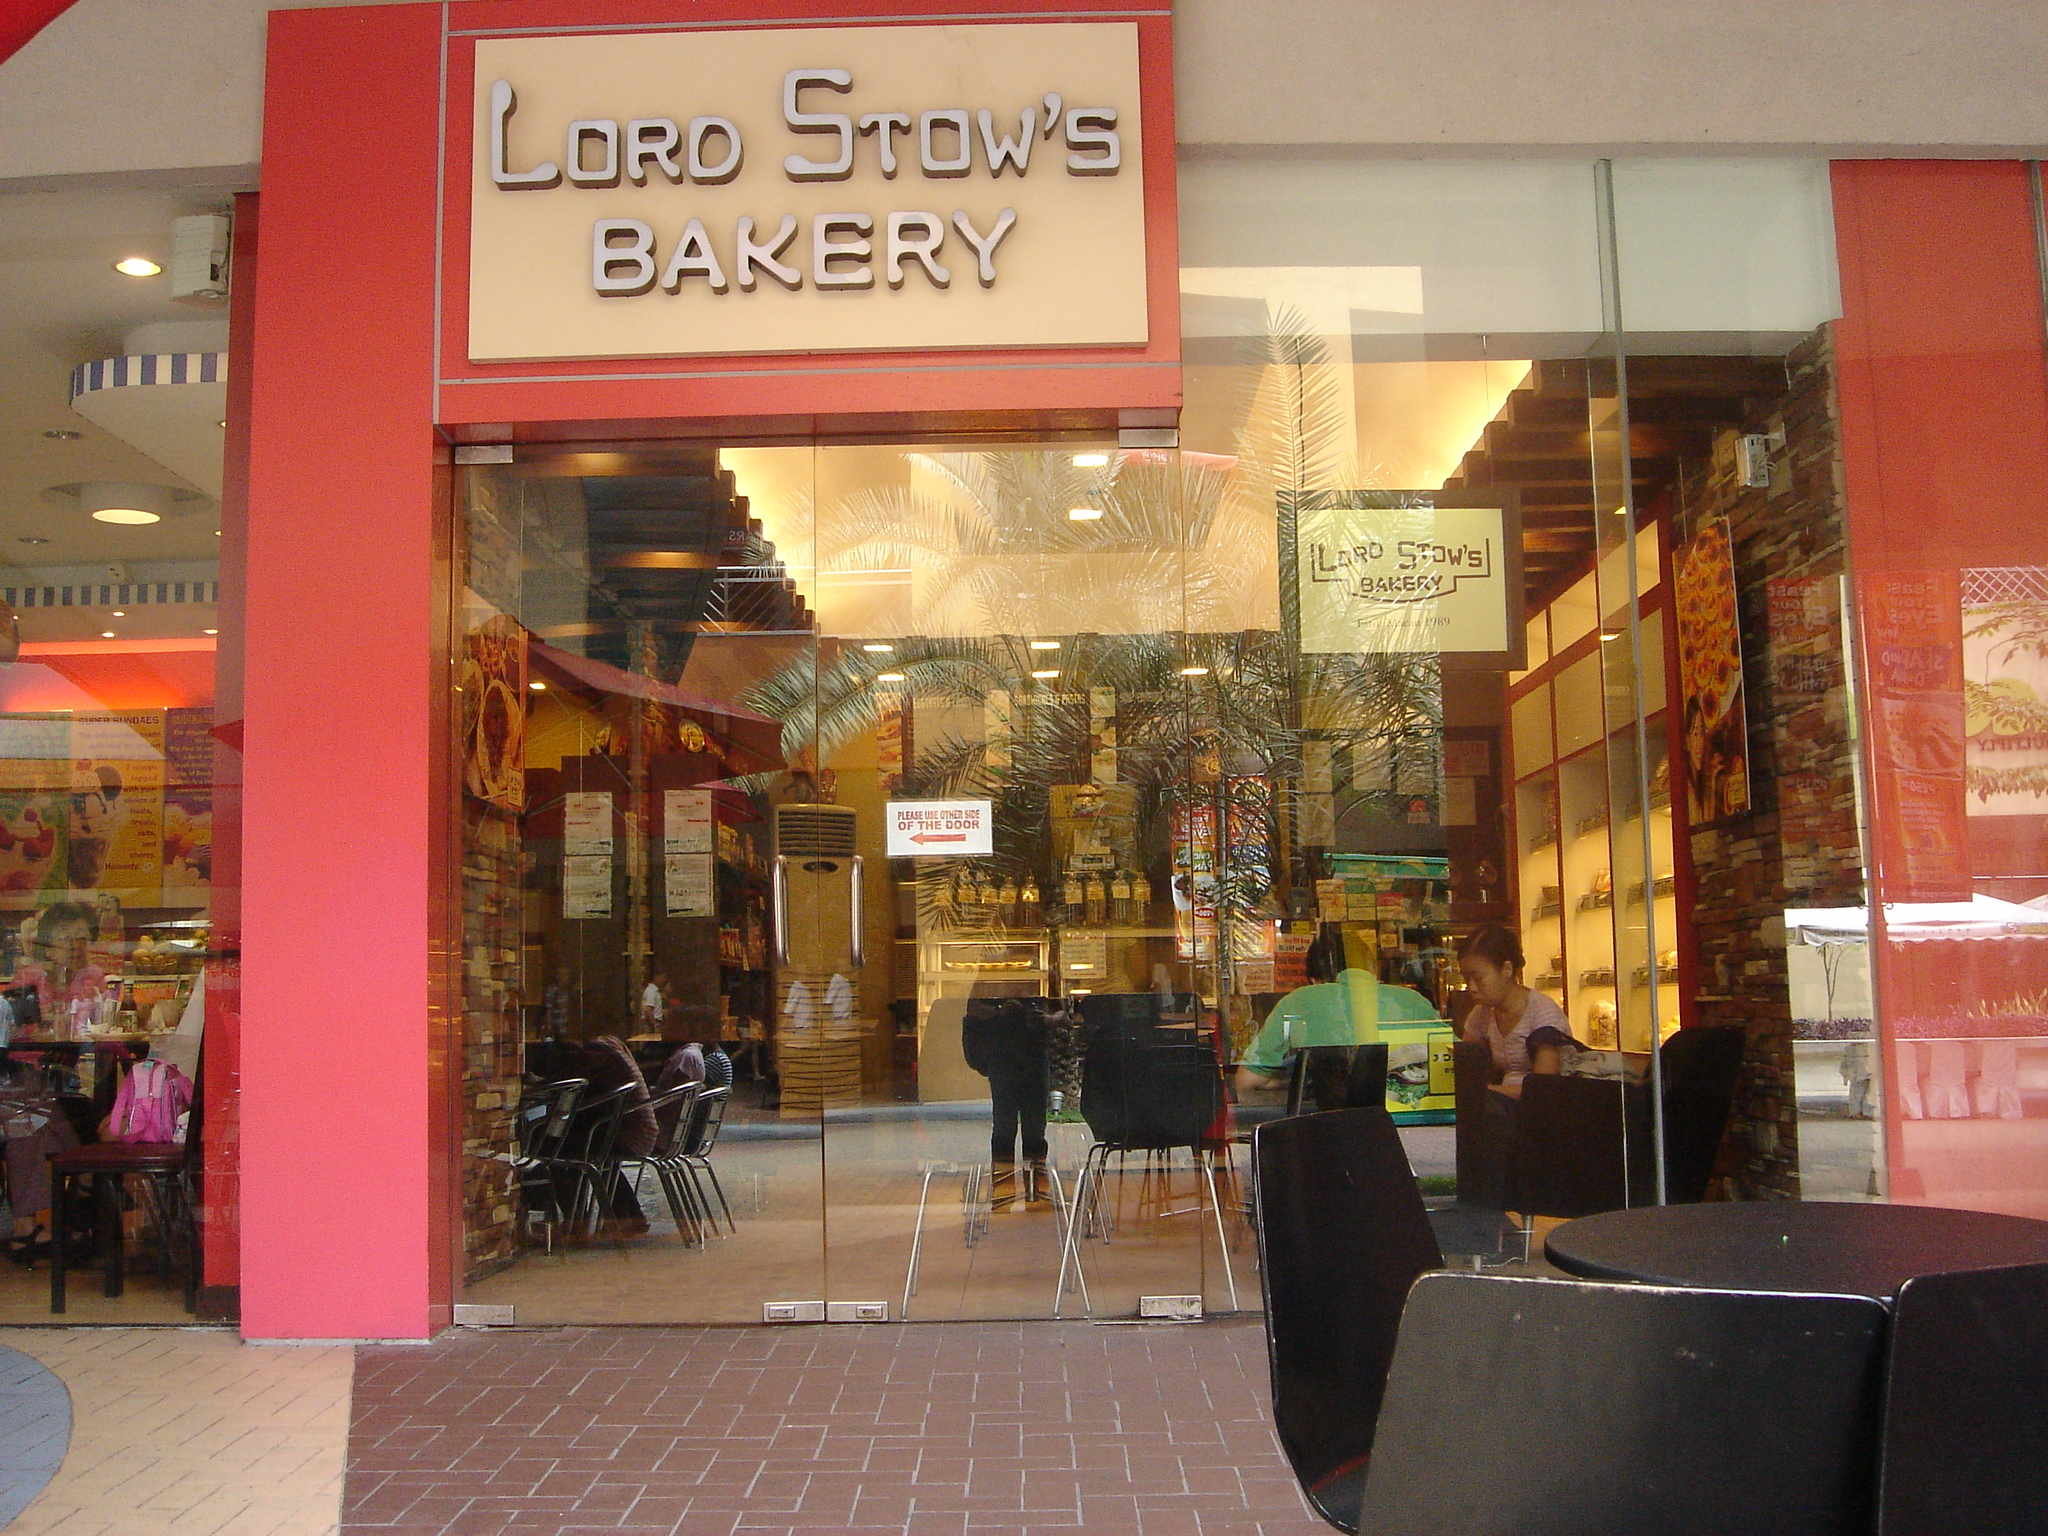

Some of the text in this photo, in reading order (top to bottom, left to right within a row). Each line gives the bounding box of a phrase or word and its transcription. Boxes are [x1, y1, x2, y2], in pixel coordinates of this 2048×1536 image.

[490, 68, 1121, 191] LORD STOW'S
[592, 206, 1018, 297] BAKERY
[1397, 540, 1483, 570] STOW'S
[1360, 574, 1443, 593] BAKERY
[897, 808, 980, 821] PLEASE USE OTHER SIDE
[897, 819, 980, 831] OF THE DOOR
